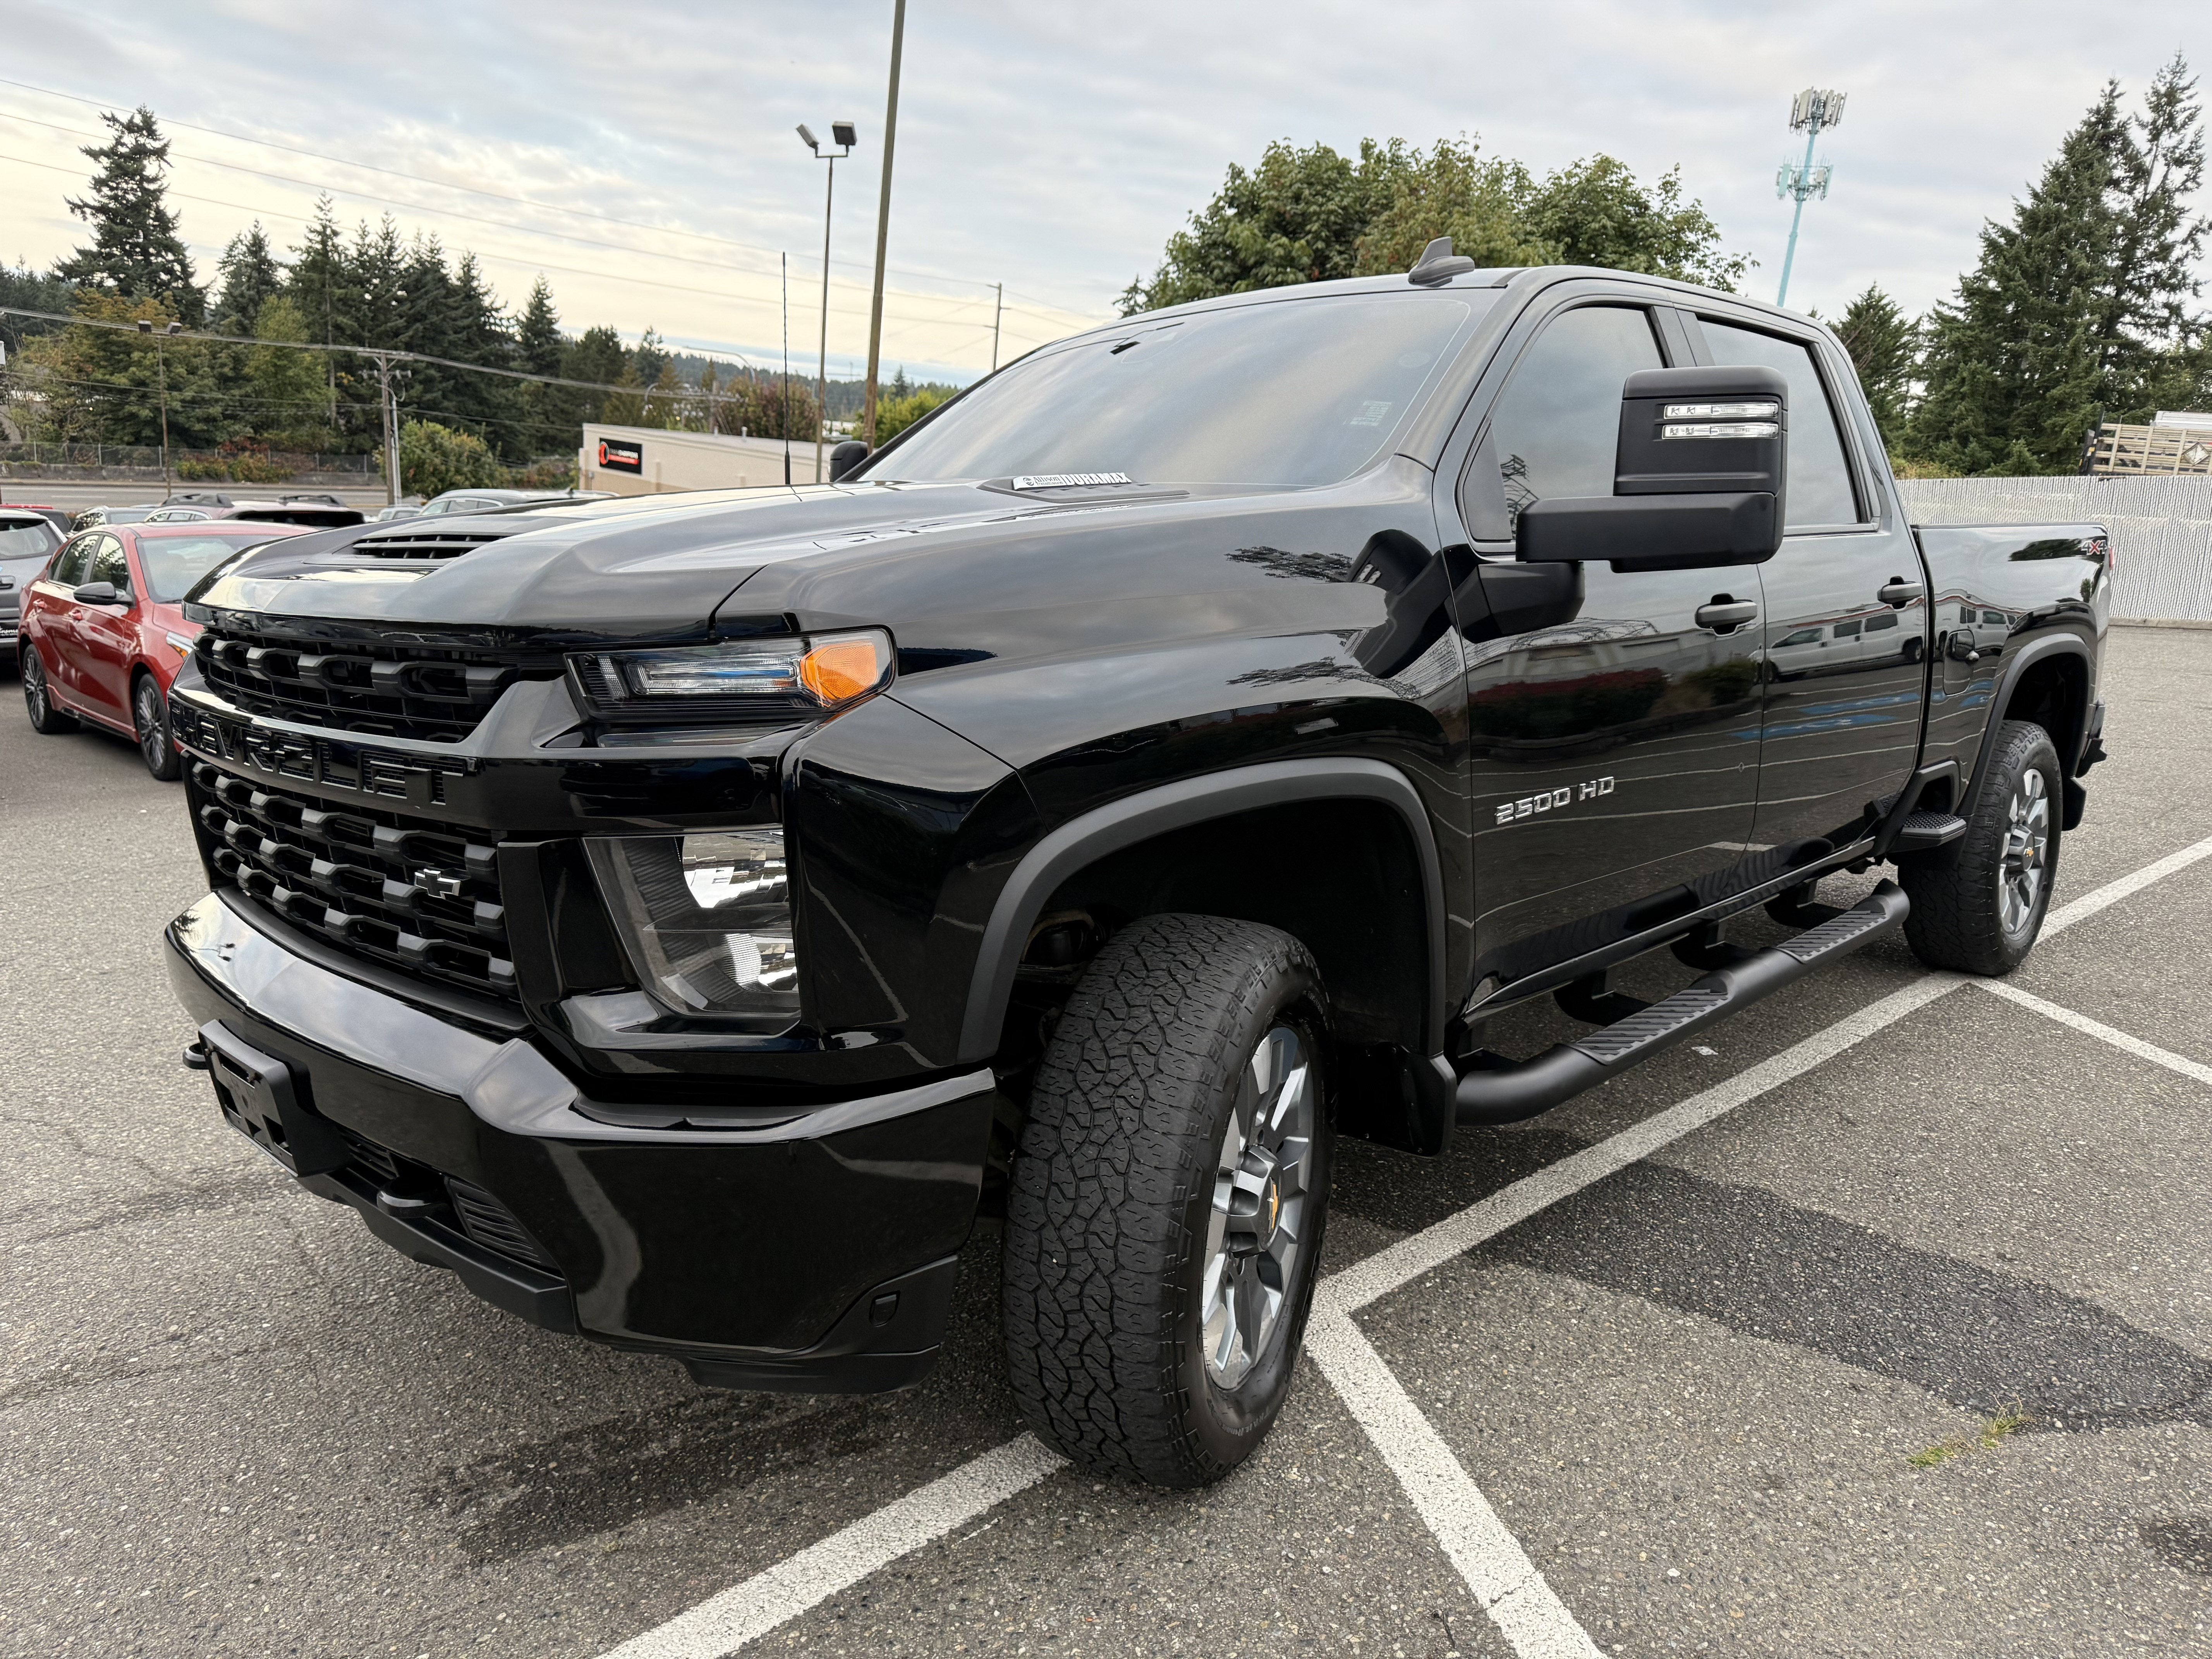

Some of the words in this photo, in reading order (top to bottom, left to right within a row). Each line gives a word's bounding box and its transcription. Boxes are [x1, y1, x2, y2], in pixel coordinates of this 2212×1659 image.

[1064, 472, 1132, 486] DURAMAX
[169, 698, 465, 805] CHEVROLET
[1494, 787, 1571, 825] 2500
[1577, 776, 1614, 801] HD
